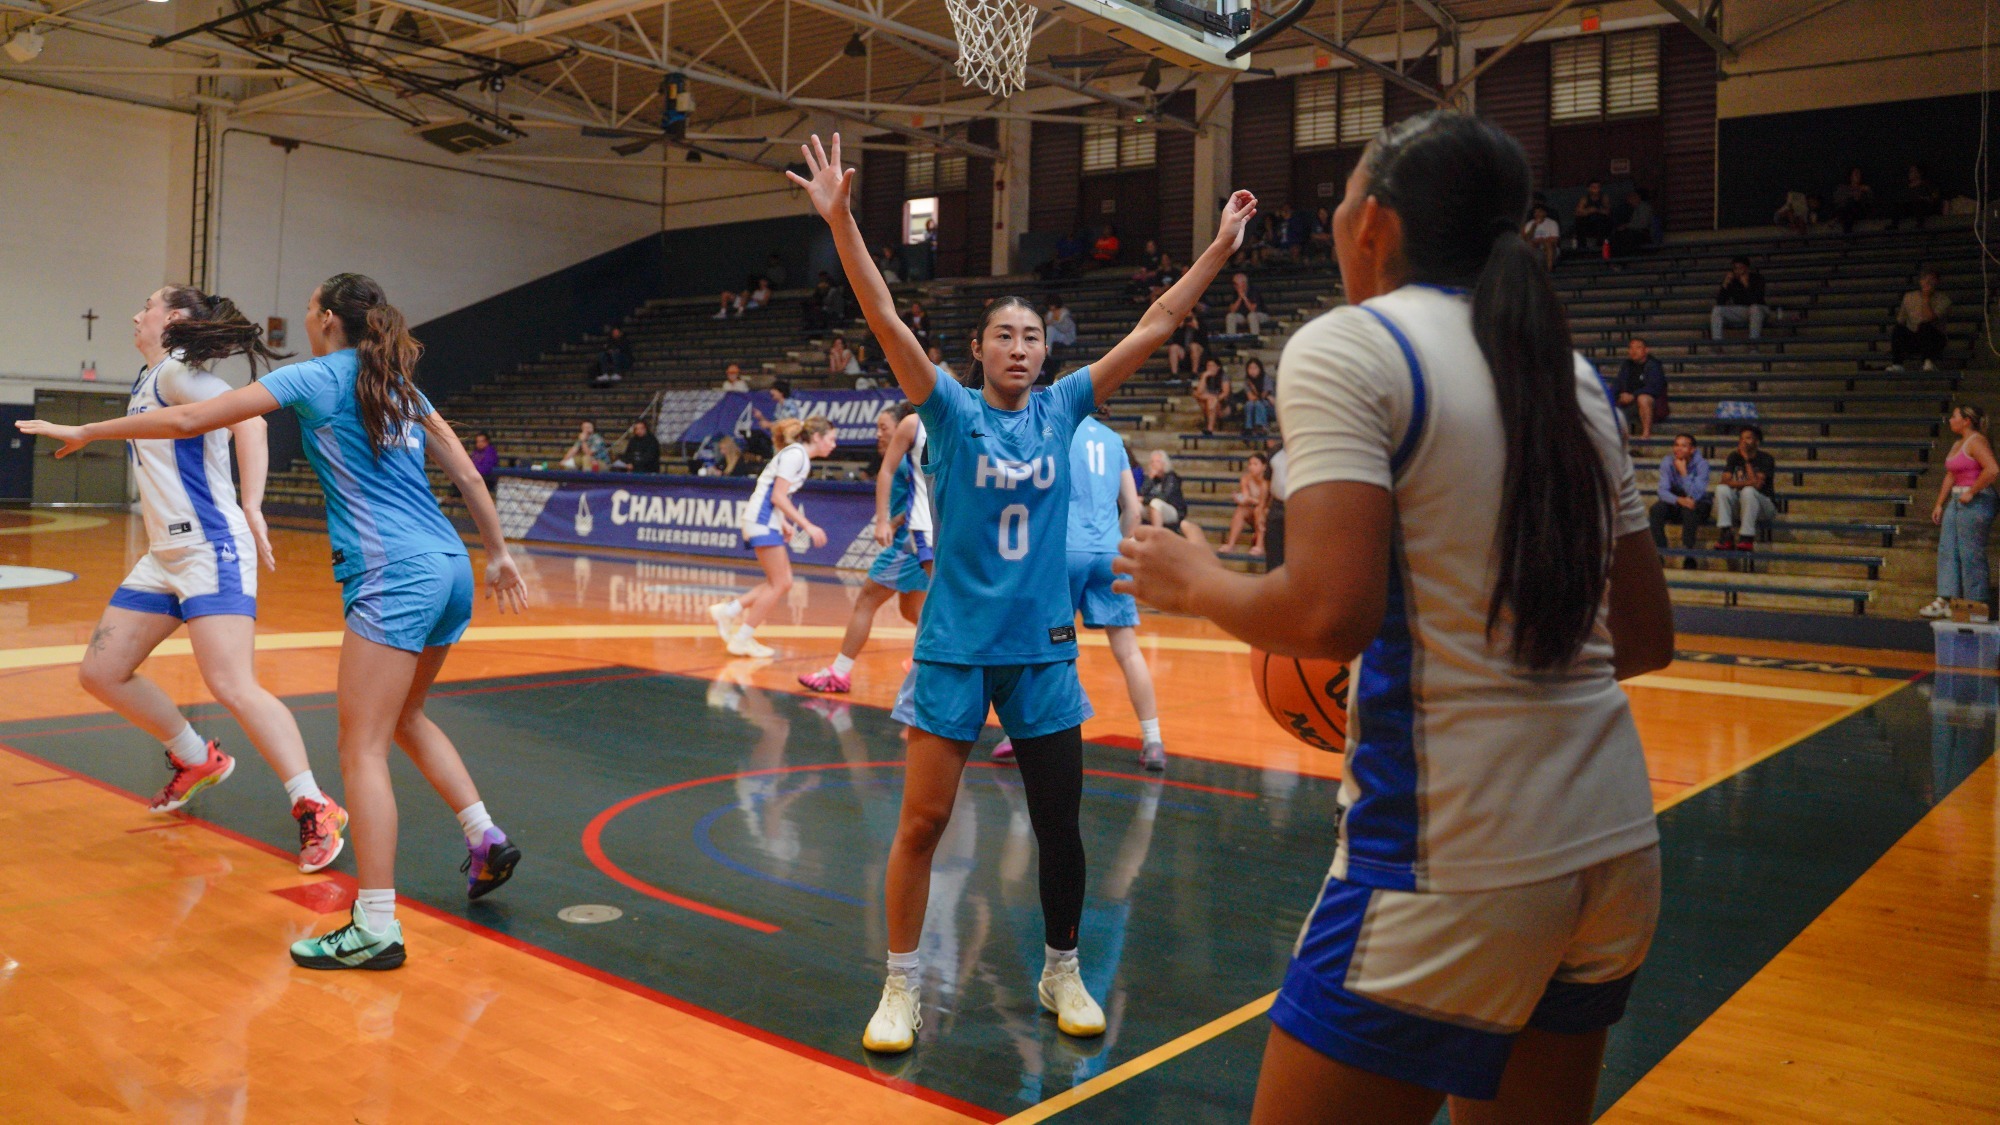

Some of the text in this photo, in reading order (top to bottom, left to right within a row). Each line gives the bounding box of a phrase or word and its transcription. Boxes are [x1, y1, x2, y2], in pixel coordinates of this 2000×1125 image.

[796, 399, 909, 424] HAMINA
[975, 455, 1056, 490] HPU
[1086, 440, 1105, 476] 11
[636, 527, 737, 549] SILVERSWORDS
[998, 504, 1029, 561] 0
